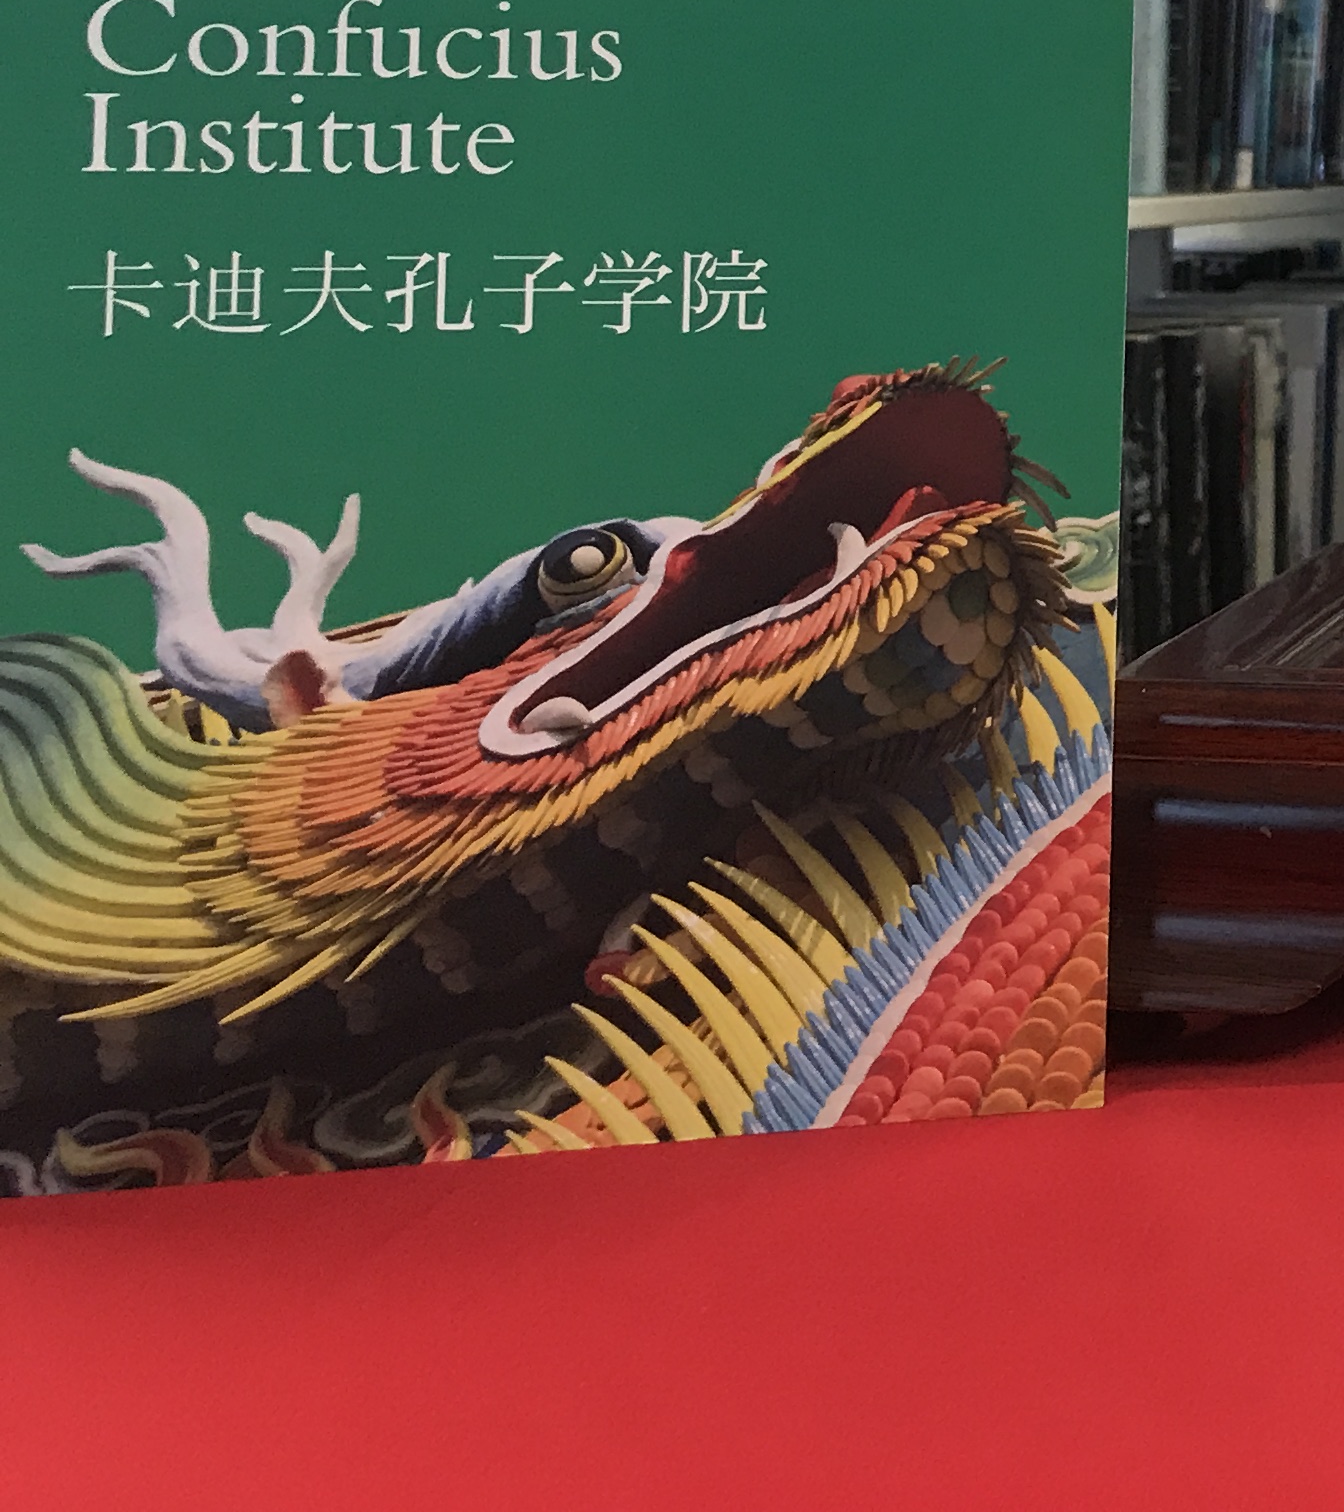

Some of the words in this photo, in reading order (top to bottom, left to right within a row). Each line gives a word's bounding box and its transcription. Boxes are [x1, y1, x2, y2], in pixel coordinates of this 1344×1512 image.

[81, 92, 515, 175] Institute
[67, 249, 769, 337] 卡迪夫孔子学院
